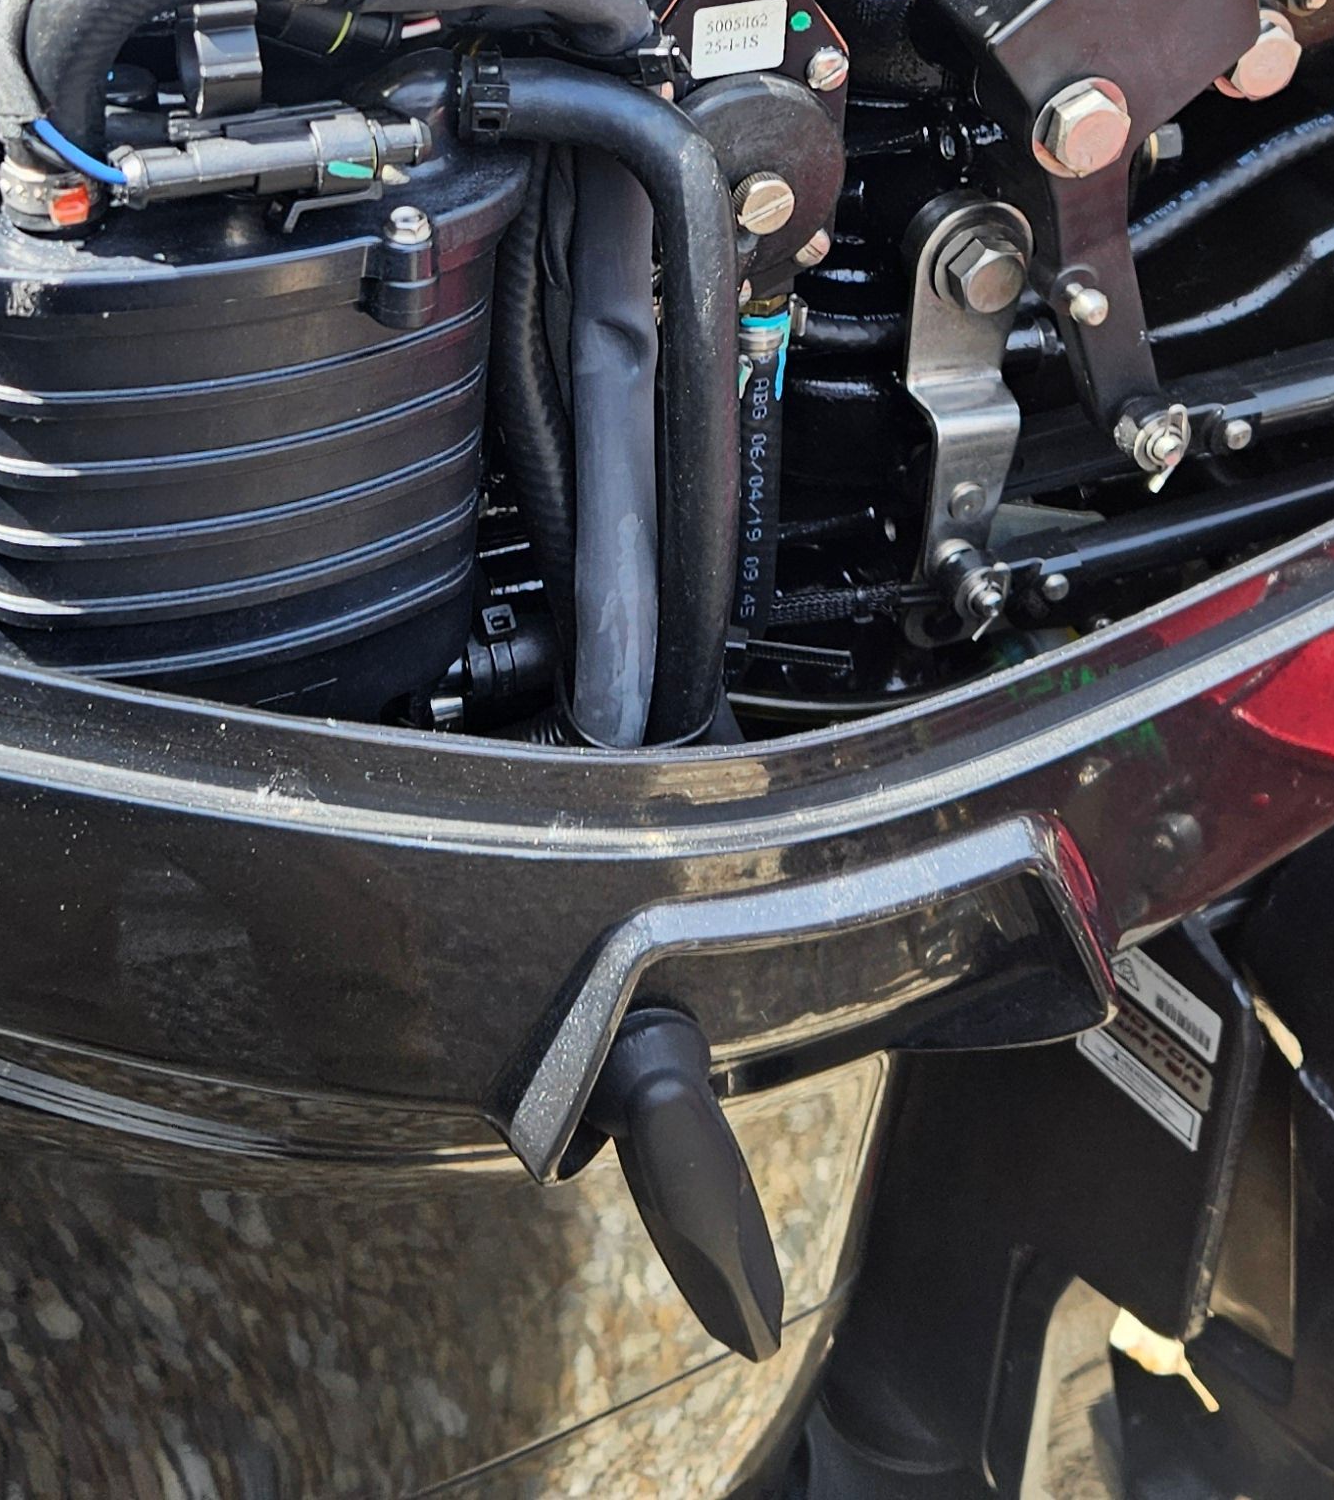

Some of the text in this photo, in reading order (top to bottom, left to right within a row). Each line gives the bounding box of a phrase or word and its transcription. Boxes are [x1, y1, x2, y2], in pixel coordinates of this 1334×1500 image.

[739, 377, 771, 619] ABG 06/04/19 09:45
